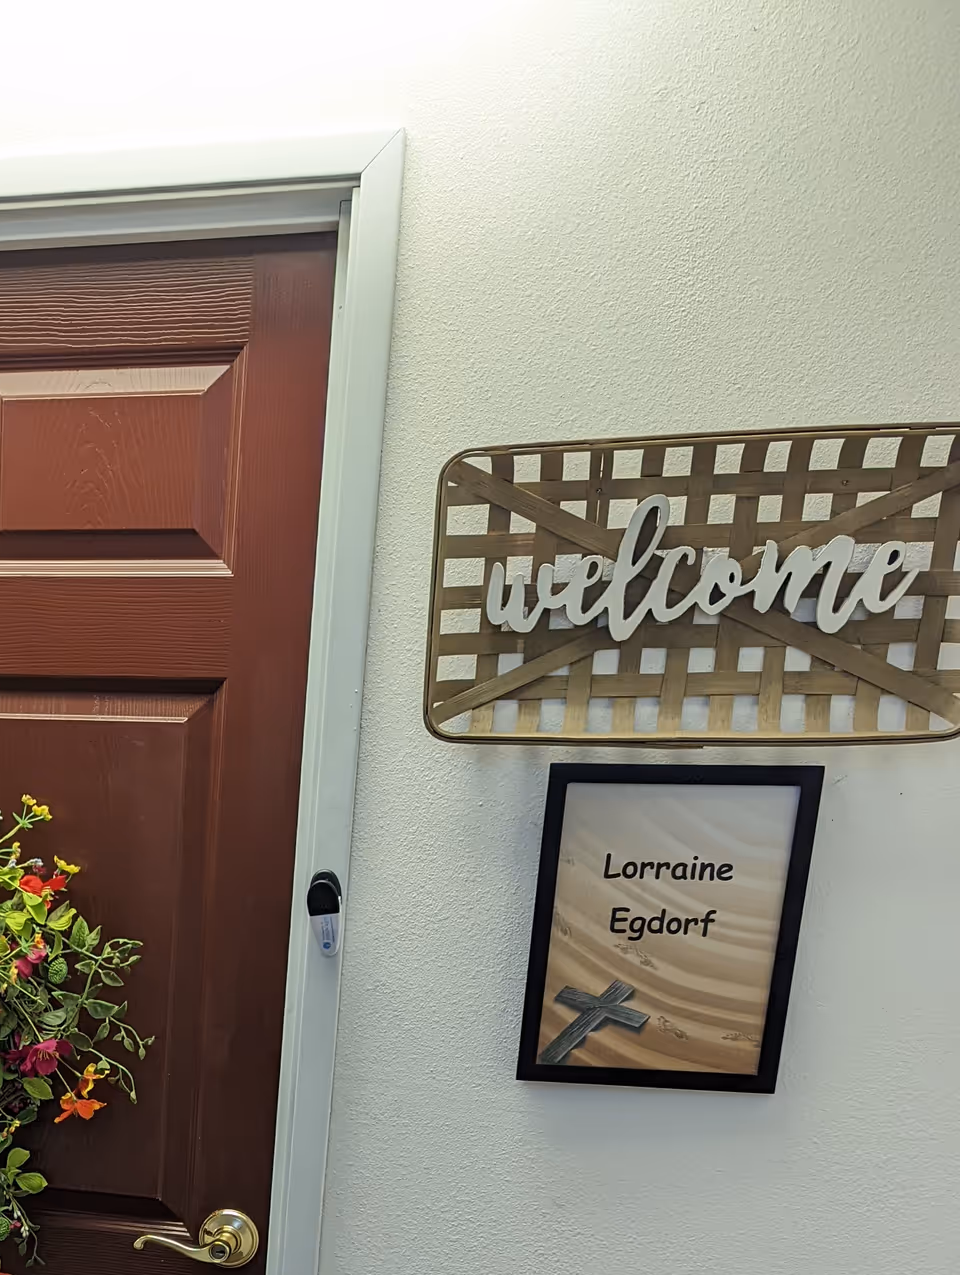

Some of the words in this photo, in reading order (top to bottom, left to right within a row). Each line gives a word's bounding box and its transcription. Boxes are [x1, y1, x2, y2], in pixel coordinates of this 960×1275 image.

[486, 493, 921, 642] welcome
[603, 853, 734, 881] Lorraine
[609, 907, 717, 941] Egdorf
